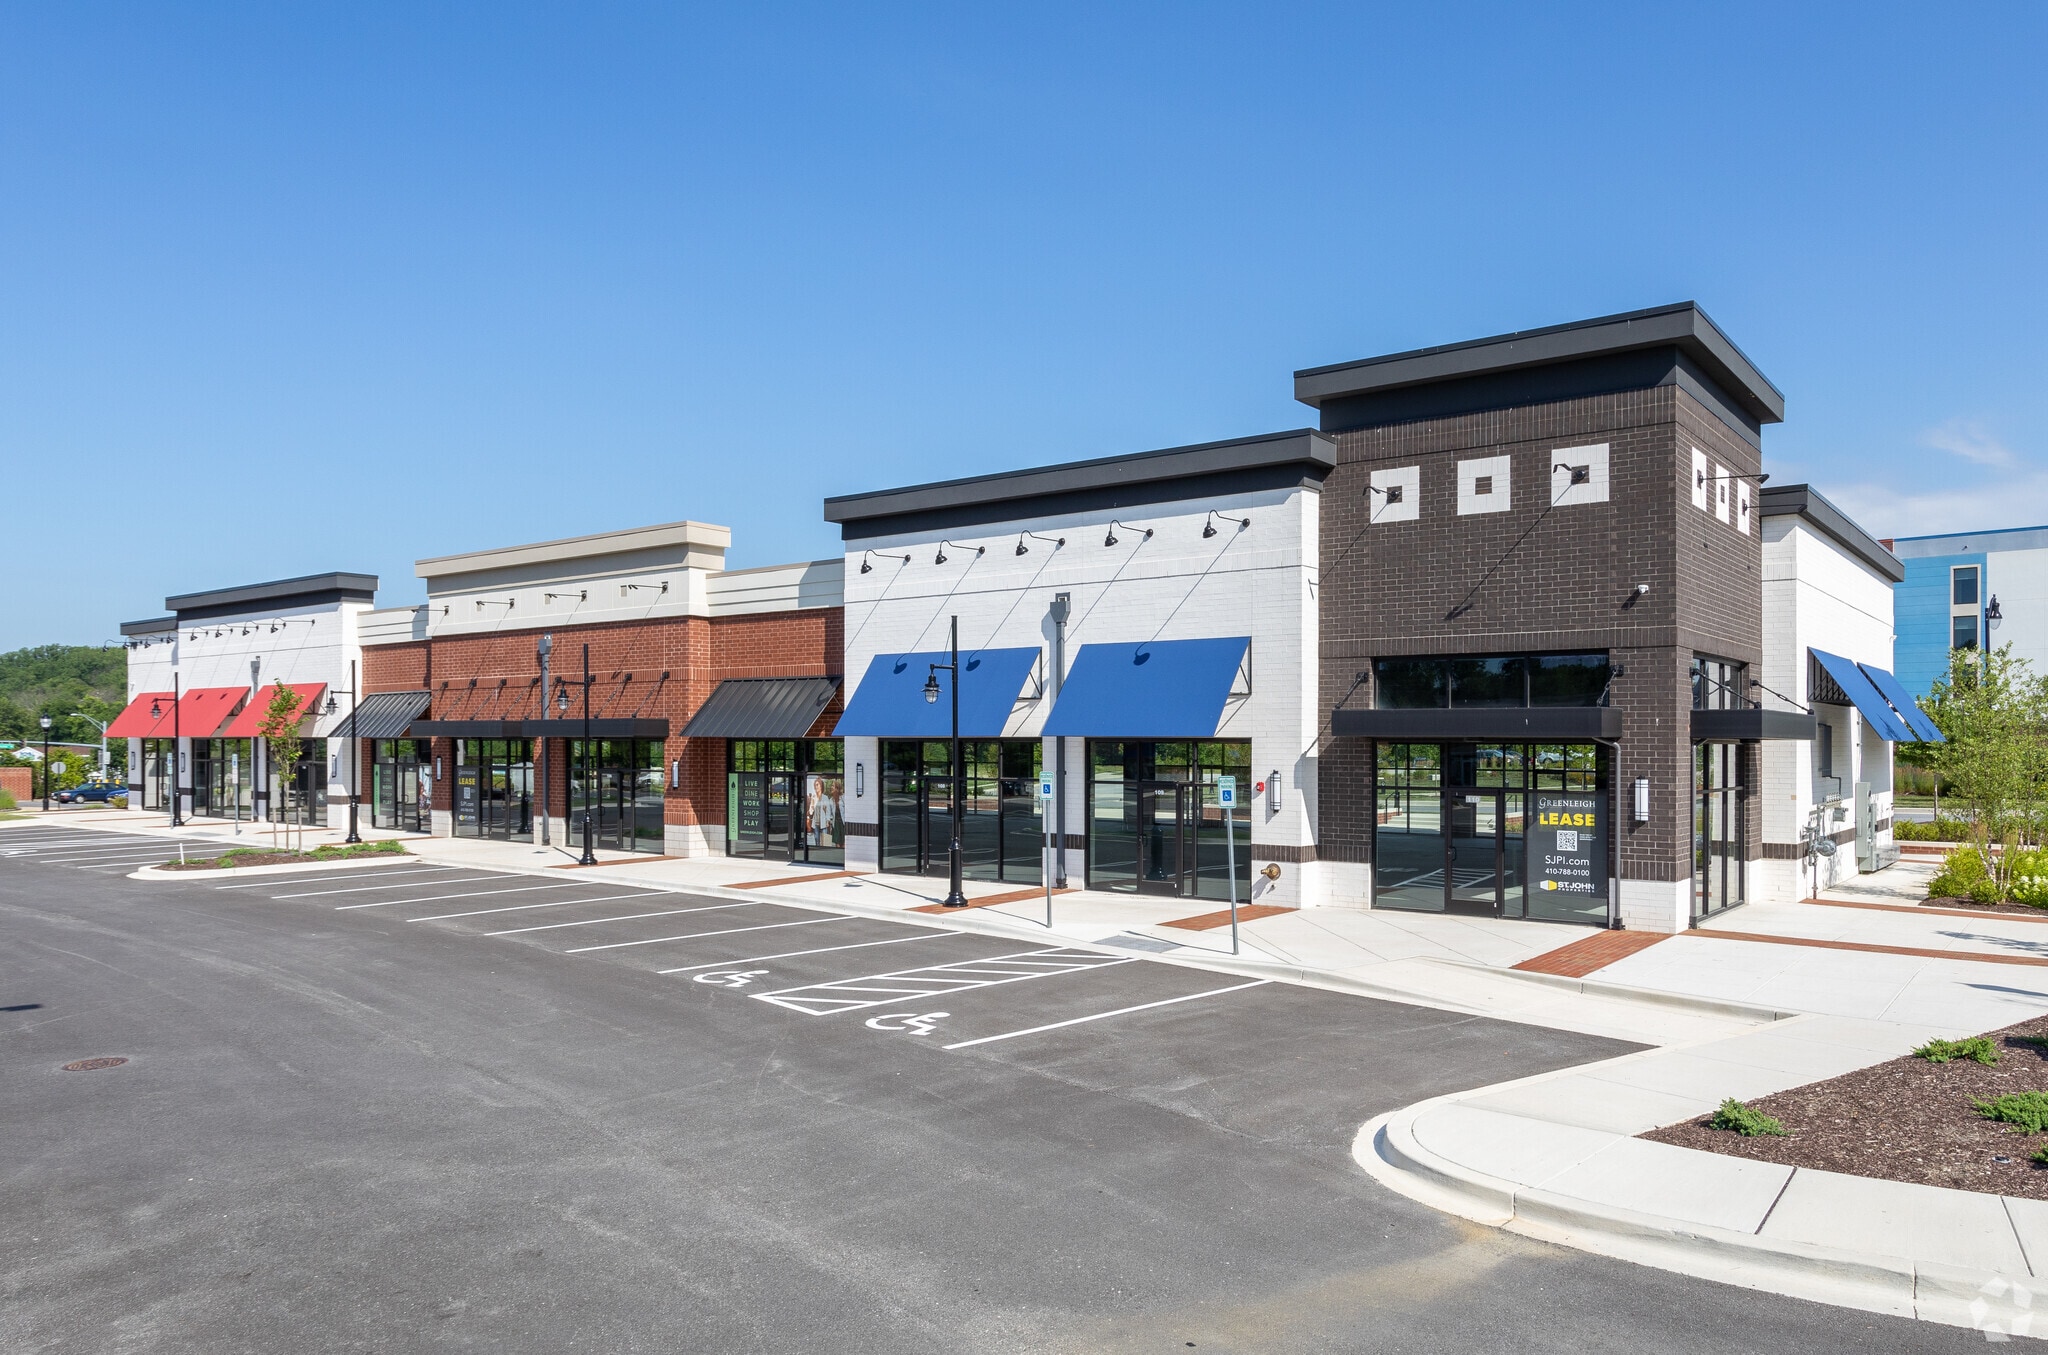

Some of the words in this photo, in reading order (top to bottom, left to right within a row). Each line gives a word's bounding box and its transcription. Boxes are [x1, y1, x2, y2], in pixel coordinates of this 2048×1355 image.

[459, 777, 475, 785] LEASE
[1539, 797, 1596, 809] GREENLEIGH
[1539, 812, 1595, 827] LEASE
[1545, 855, 1590, 866] SJPI.com
[1545, 868, 1590, 877] 410-788-0100
